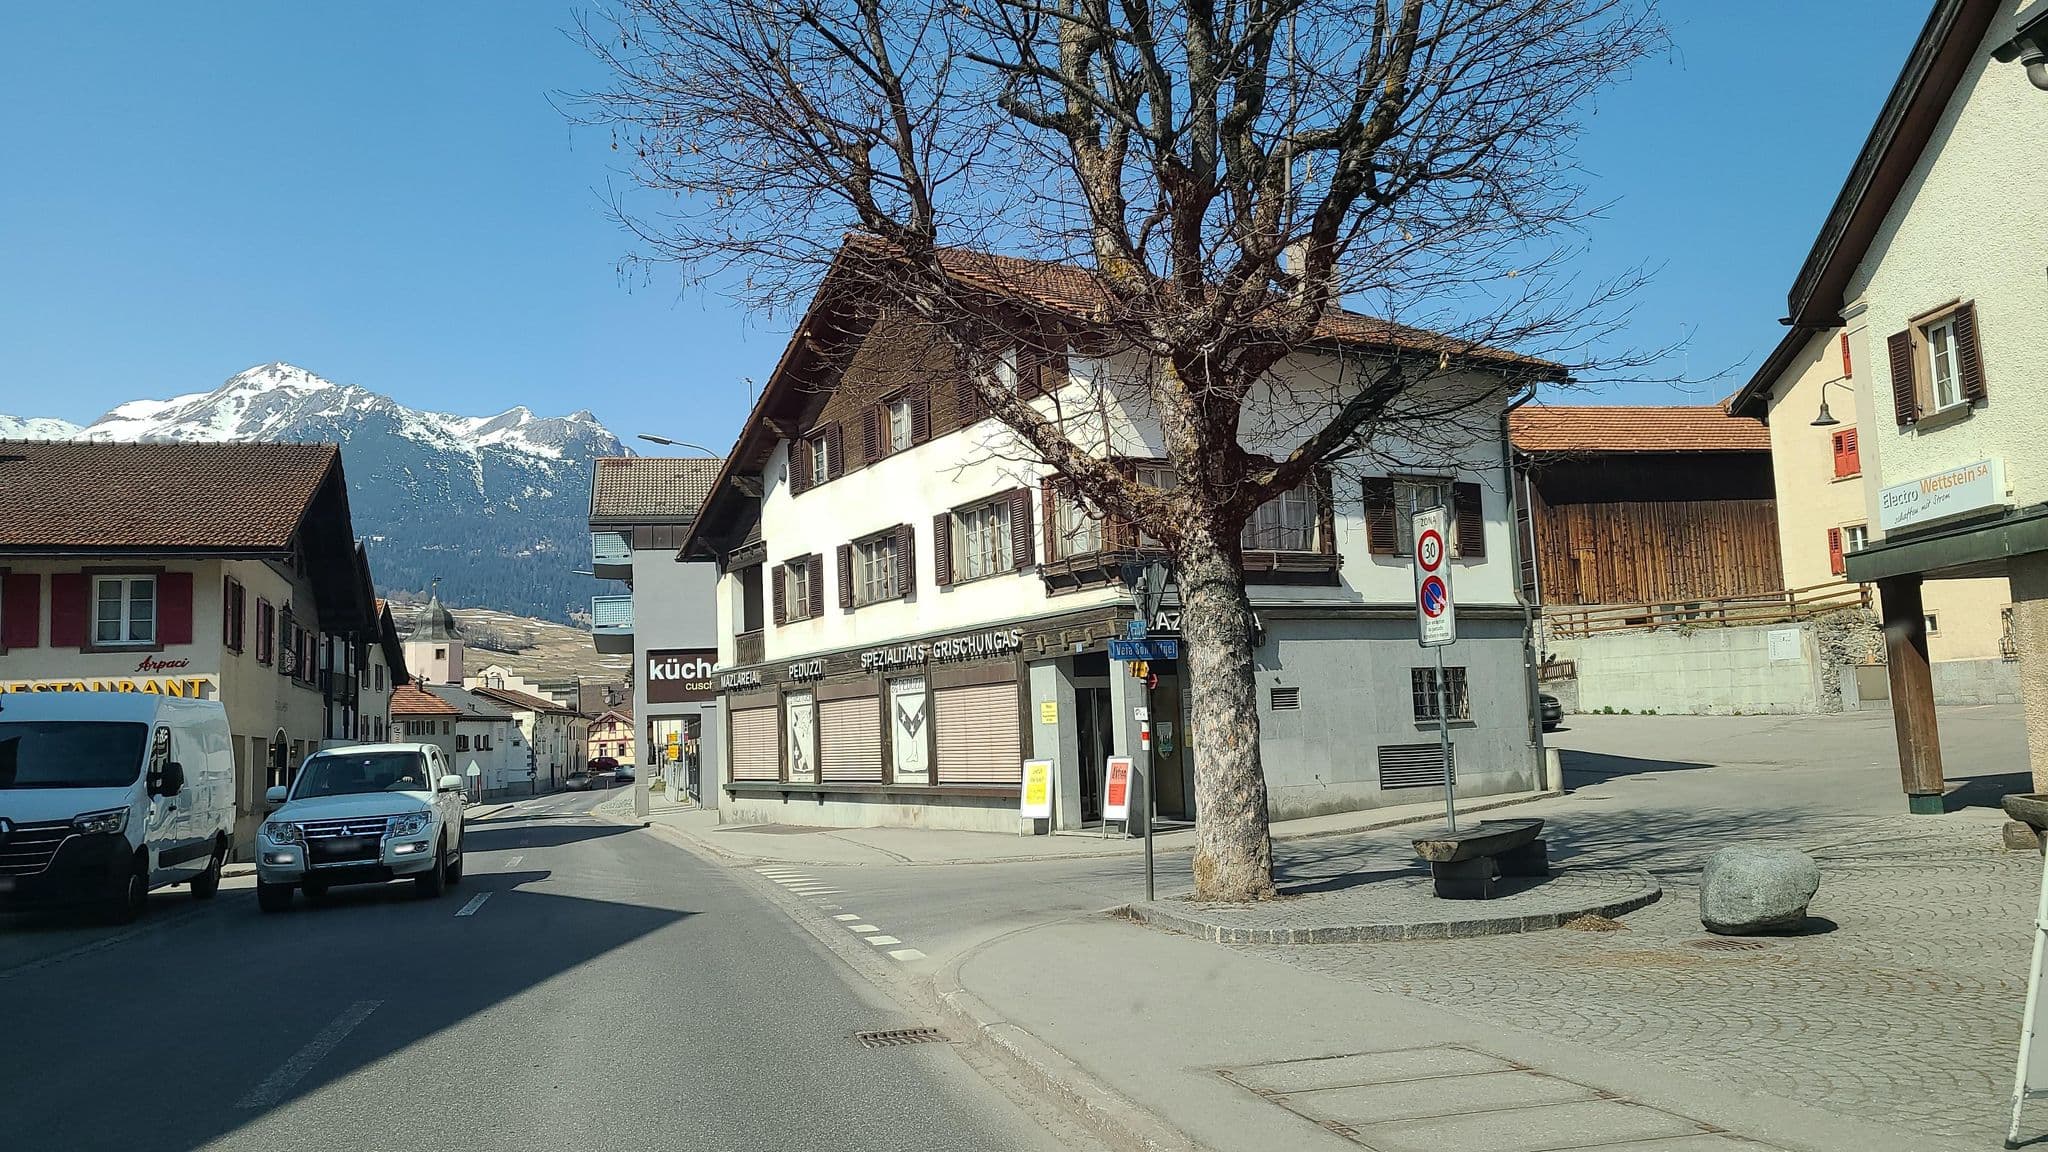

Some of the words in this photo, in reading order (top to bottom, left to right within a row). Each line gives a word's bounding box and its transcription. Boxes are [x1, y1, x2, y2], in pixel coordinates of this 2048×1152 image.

[1883, 490, 1918, 509] Electro
[1920, 468, 1975, 494] Wettstein
[1976, 464, 1988, 477] SA
[1420, 516, 1437, 527] ZONA
[1425, 541, 1436, 559] 30
[933, 628, 1019, 659] GRISCHUNGAS
[135, 655, 190, 673] Arpaci
[788, 660, 822, 679] PEDUZZI
